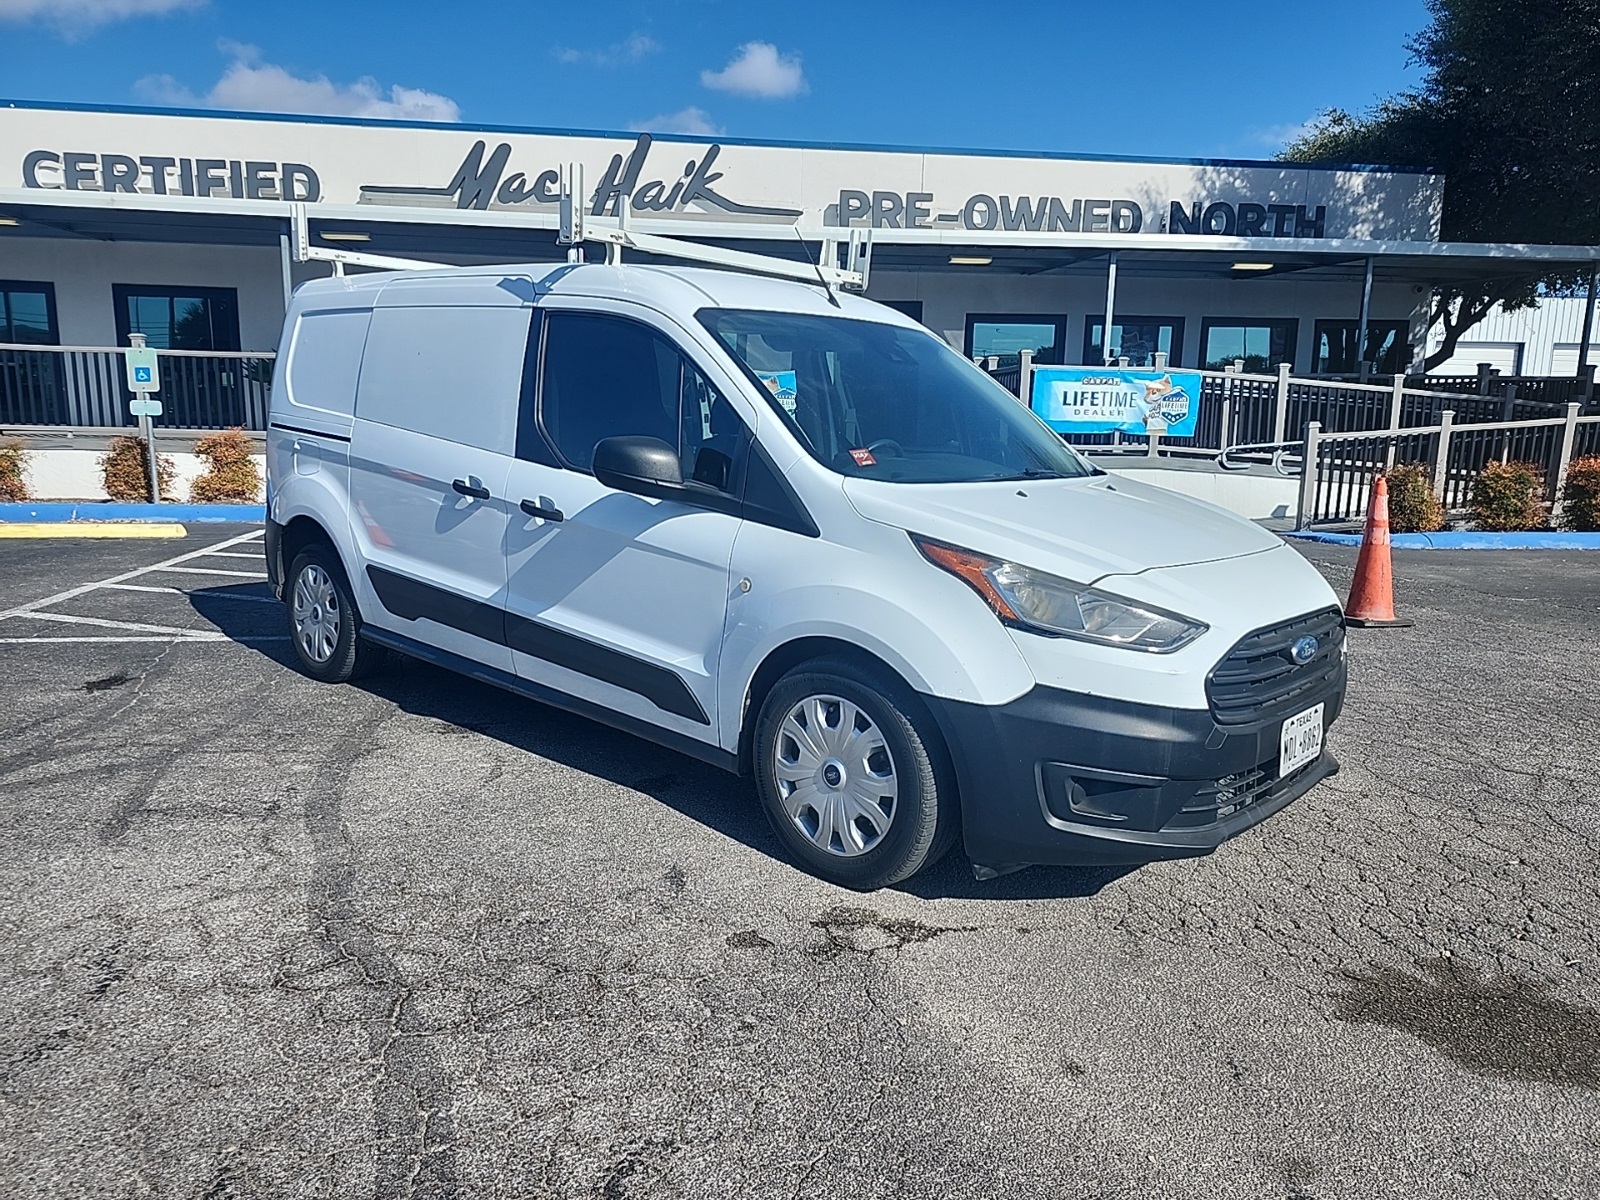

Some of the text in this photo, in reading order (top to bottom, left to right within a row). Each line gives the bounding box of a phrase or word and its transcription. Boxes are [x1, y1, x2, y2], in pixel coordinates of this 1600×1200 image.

[22, 150, 321, 203] CERTIFIED
[447, 132, 723, 217] Mac Haik
[838, 189, 1326, 239] PRE-OWNED NORTH
[1082, 377, 1121, 386] CARFAX
[1062, 390, 1138, 409] LIFETIME
[1074, 409, 1125, 417] DEALER
[1296, 712, 1312, 728] TEXAS
